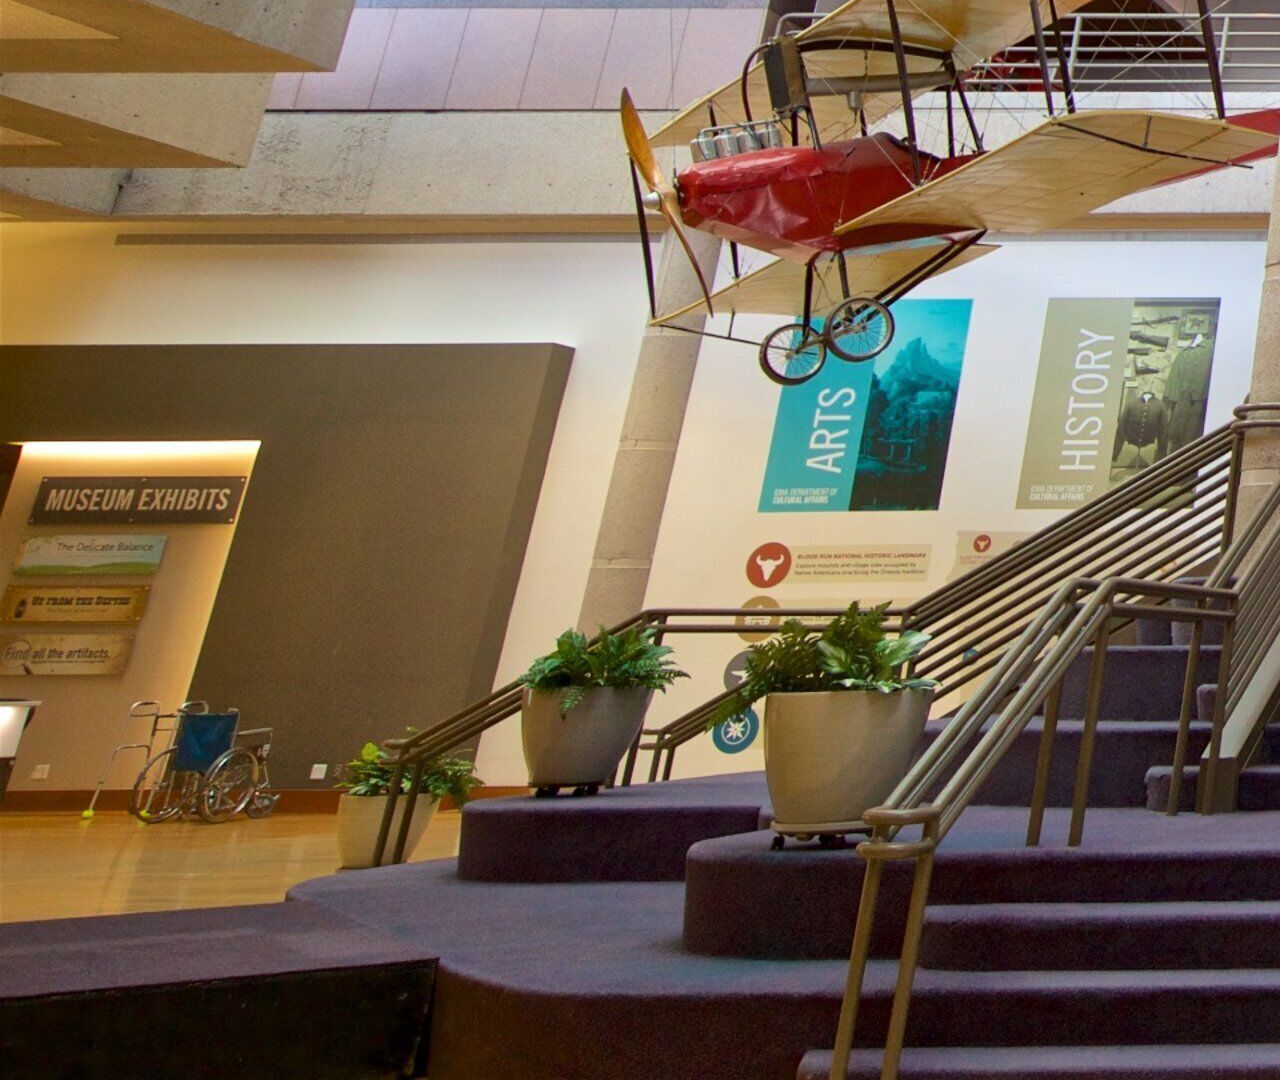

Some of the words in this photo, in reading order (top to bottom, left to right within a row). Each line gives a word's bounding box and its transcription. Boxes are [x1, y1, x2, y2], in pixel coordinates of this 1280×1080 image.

[1060, 328, 1115, 471] HISTORY
[806, 387, 857, 474] ARTS
[45, 489, 136, 511] MUSEUM
[137, 488, 231, 511] EXHIBITS
[56, 542, 73, 551] The
[76, 542, 115, 551] Delicate
[117, 542, 154, 552] Balance
[4, 648, 31, 661] Find
[32, 648, 47, 660] all
[48, 648, 65, 660] the
